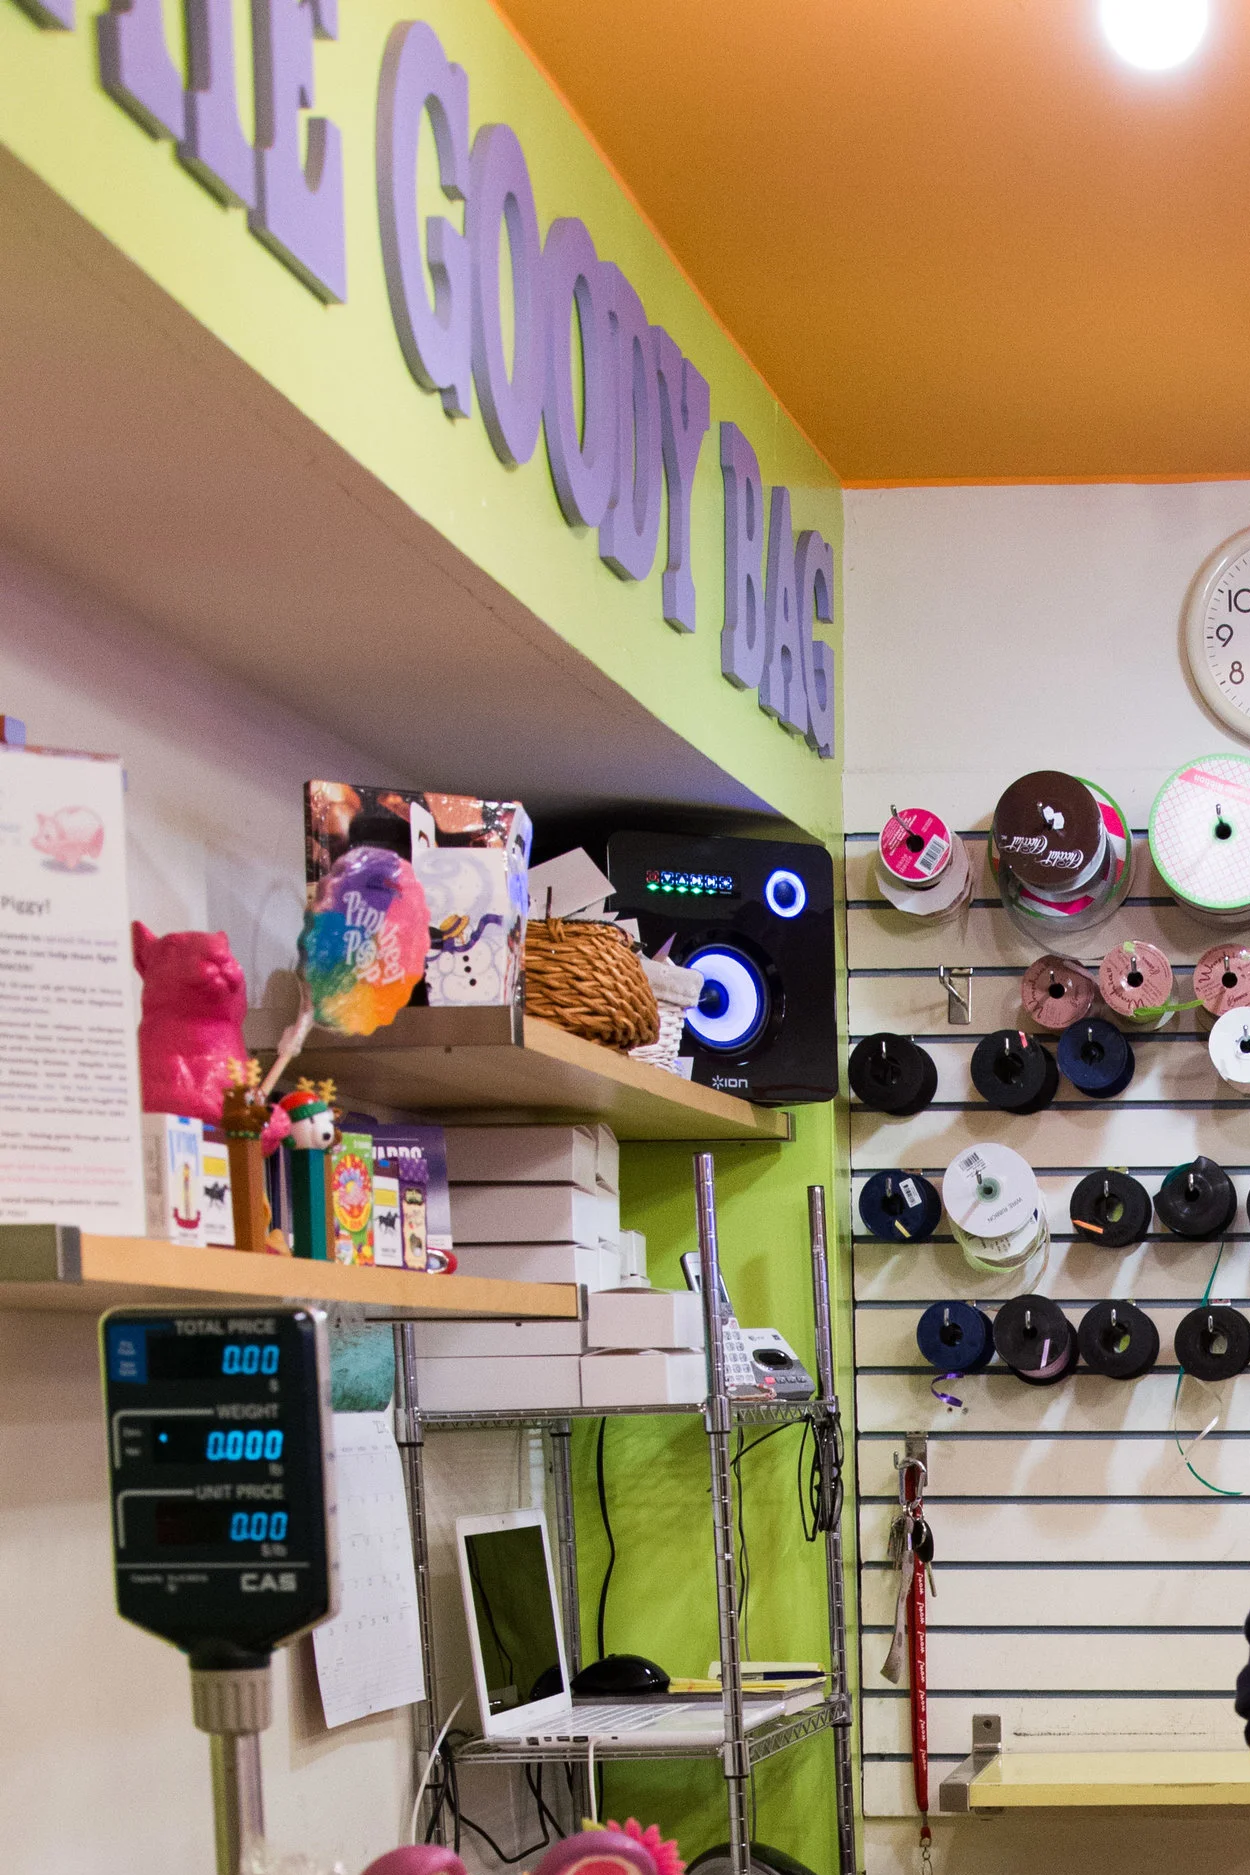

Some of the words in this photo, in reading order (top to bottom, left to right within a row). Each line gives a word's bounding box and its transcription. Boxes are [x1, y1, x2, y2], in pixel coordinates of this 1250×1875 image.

[375, 20, 710, 635] GOODY
[720, 421, 835, 759] BAG
[1216, 623, 1233, 647] 9
[1229, 660, 1244, 685] 8
[176, 1320, 224, 1336] TOTAL
[227, 1319, 277, 1335] PRICE
[216, 1403, 280, 1420] WEIGHT
[196, 1485, 231, 1501] UNIT
[236, 1483, 284, 1500] PRICE
[239, 1573, 297, 1592] CAS
